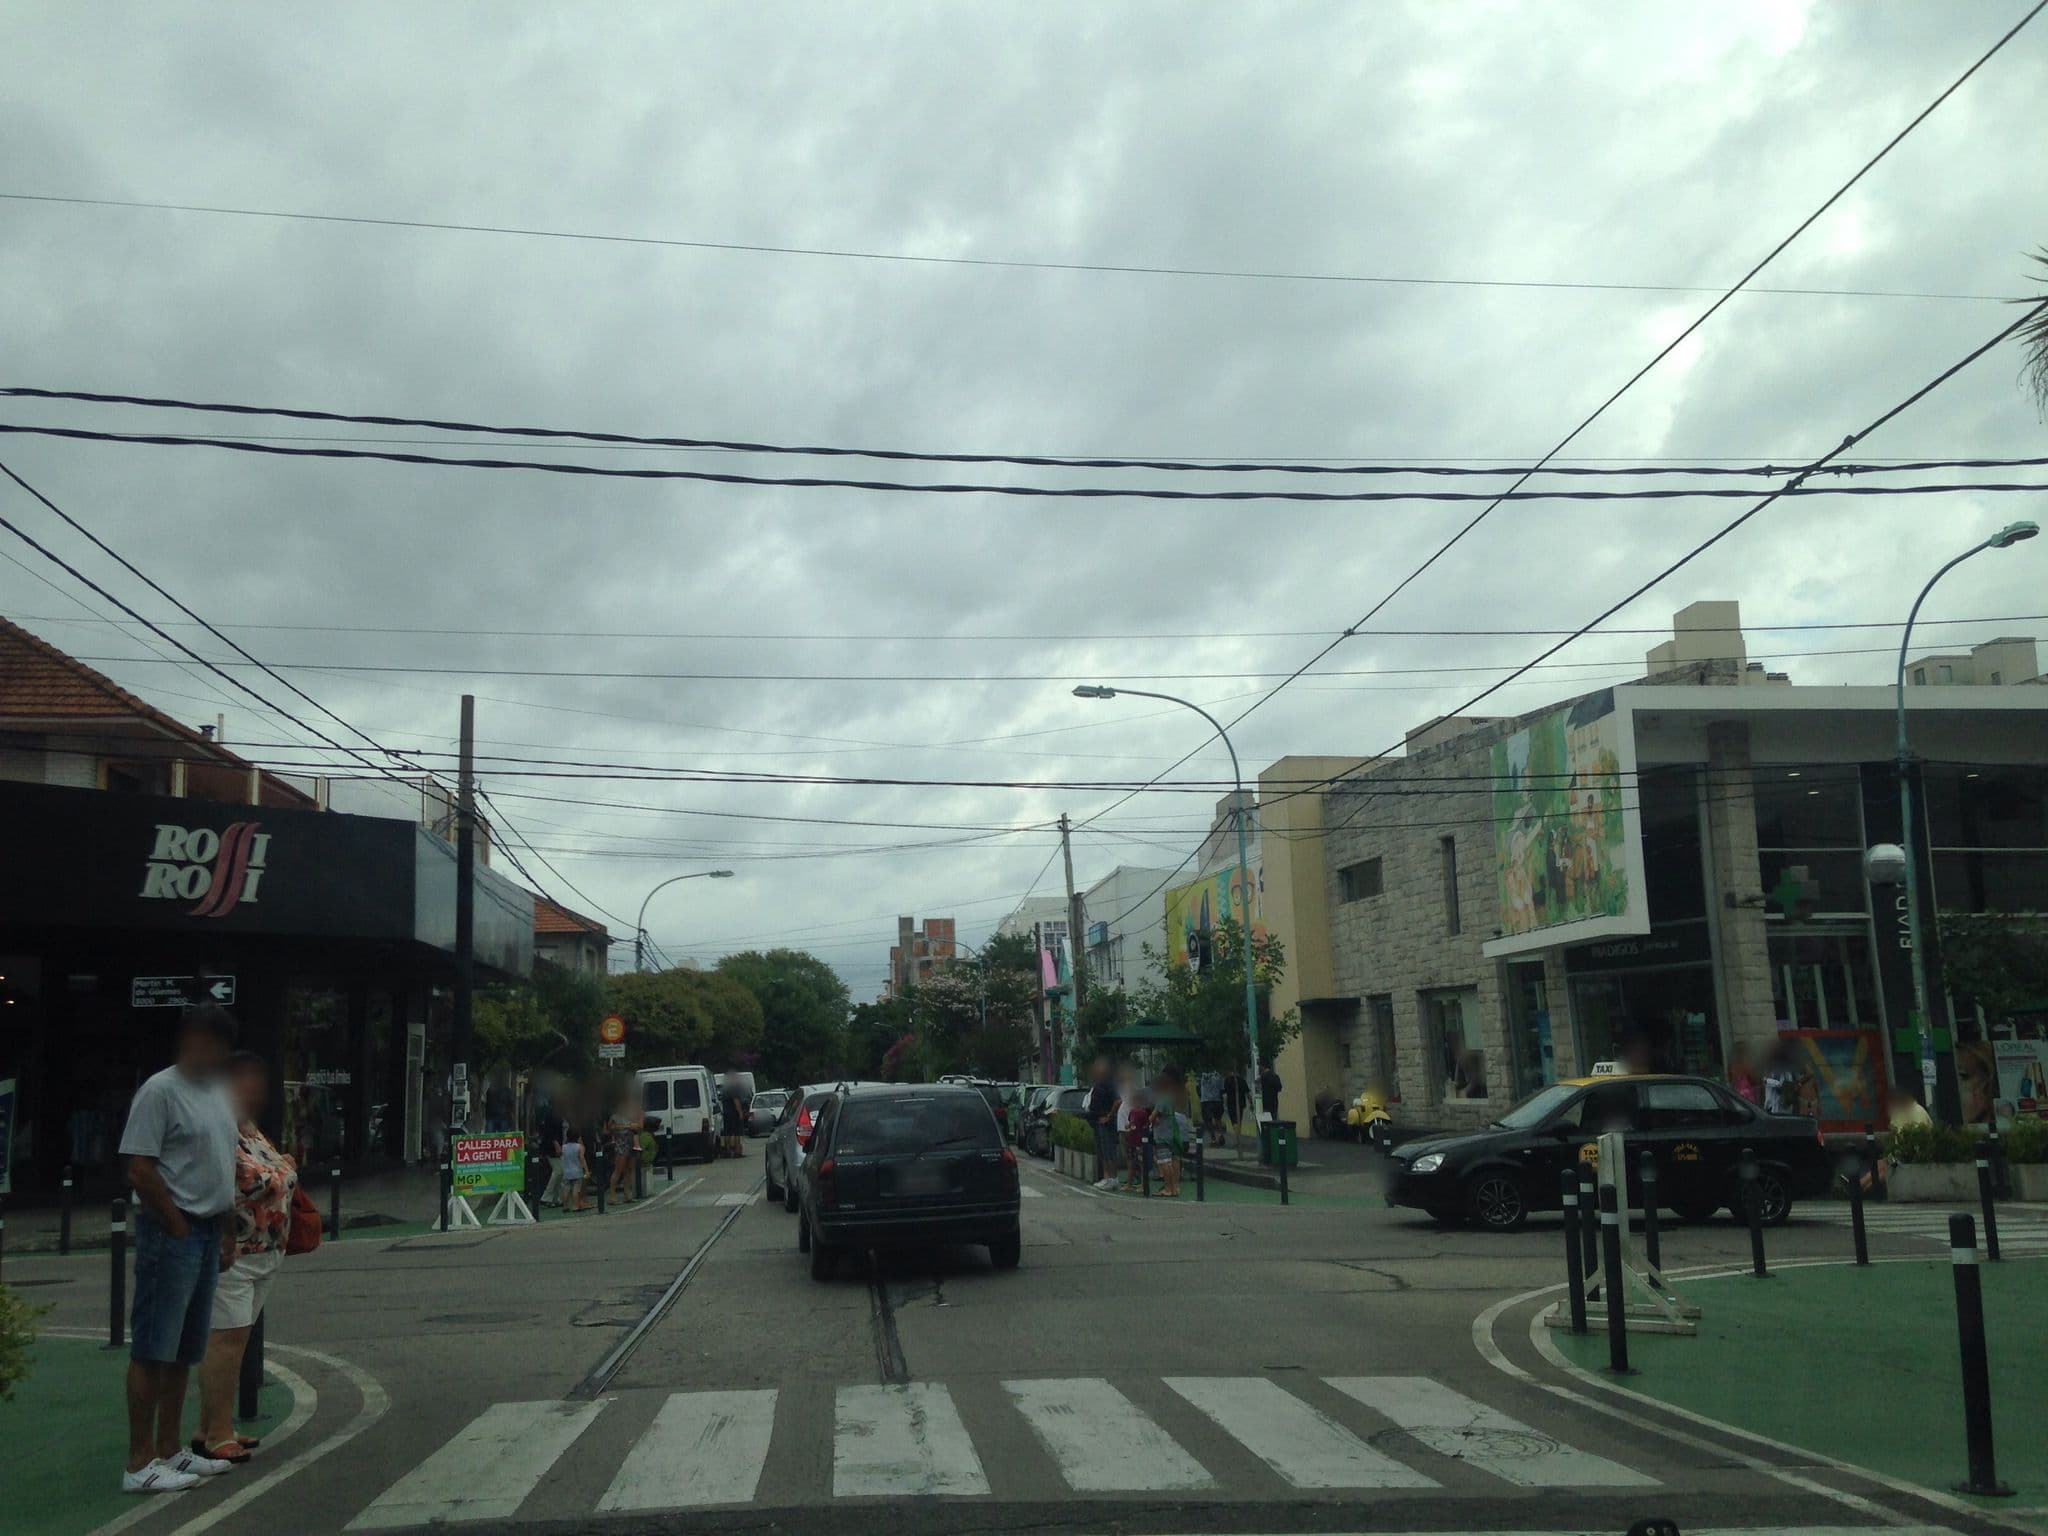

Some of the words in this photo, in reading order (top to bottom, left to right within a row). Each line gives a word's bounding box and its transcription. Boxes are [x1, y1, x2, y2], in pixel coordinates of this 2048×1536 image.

[1596, 1065, 1613, 1073] TAXI
[457, 1139, 492, 1150] CALLES
[493, 1138, 519, 1148] PARA
[457, 1152, 470, 1162] LA
[472, 1150, 503, 1161] GENTE
[457, 1174, 482, 1184] MGP
